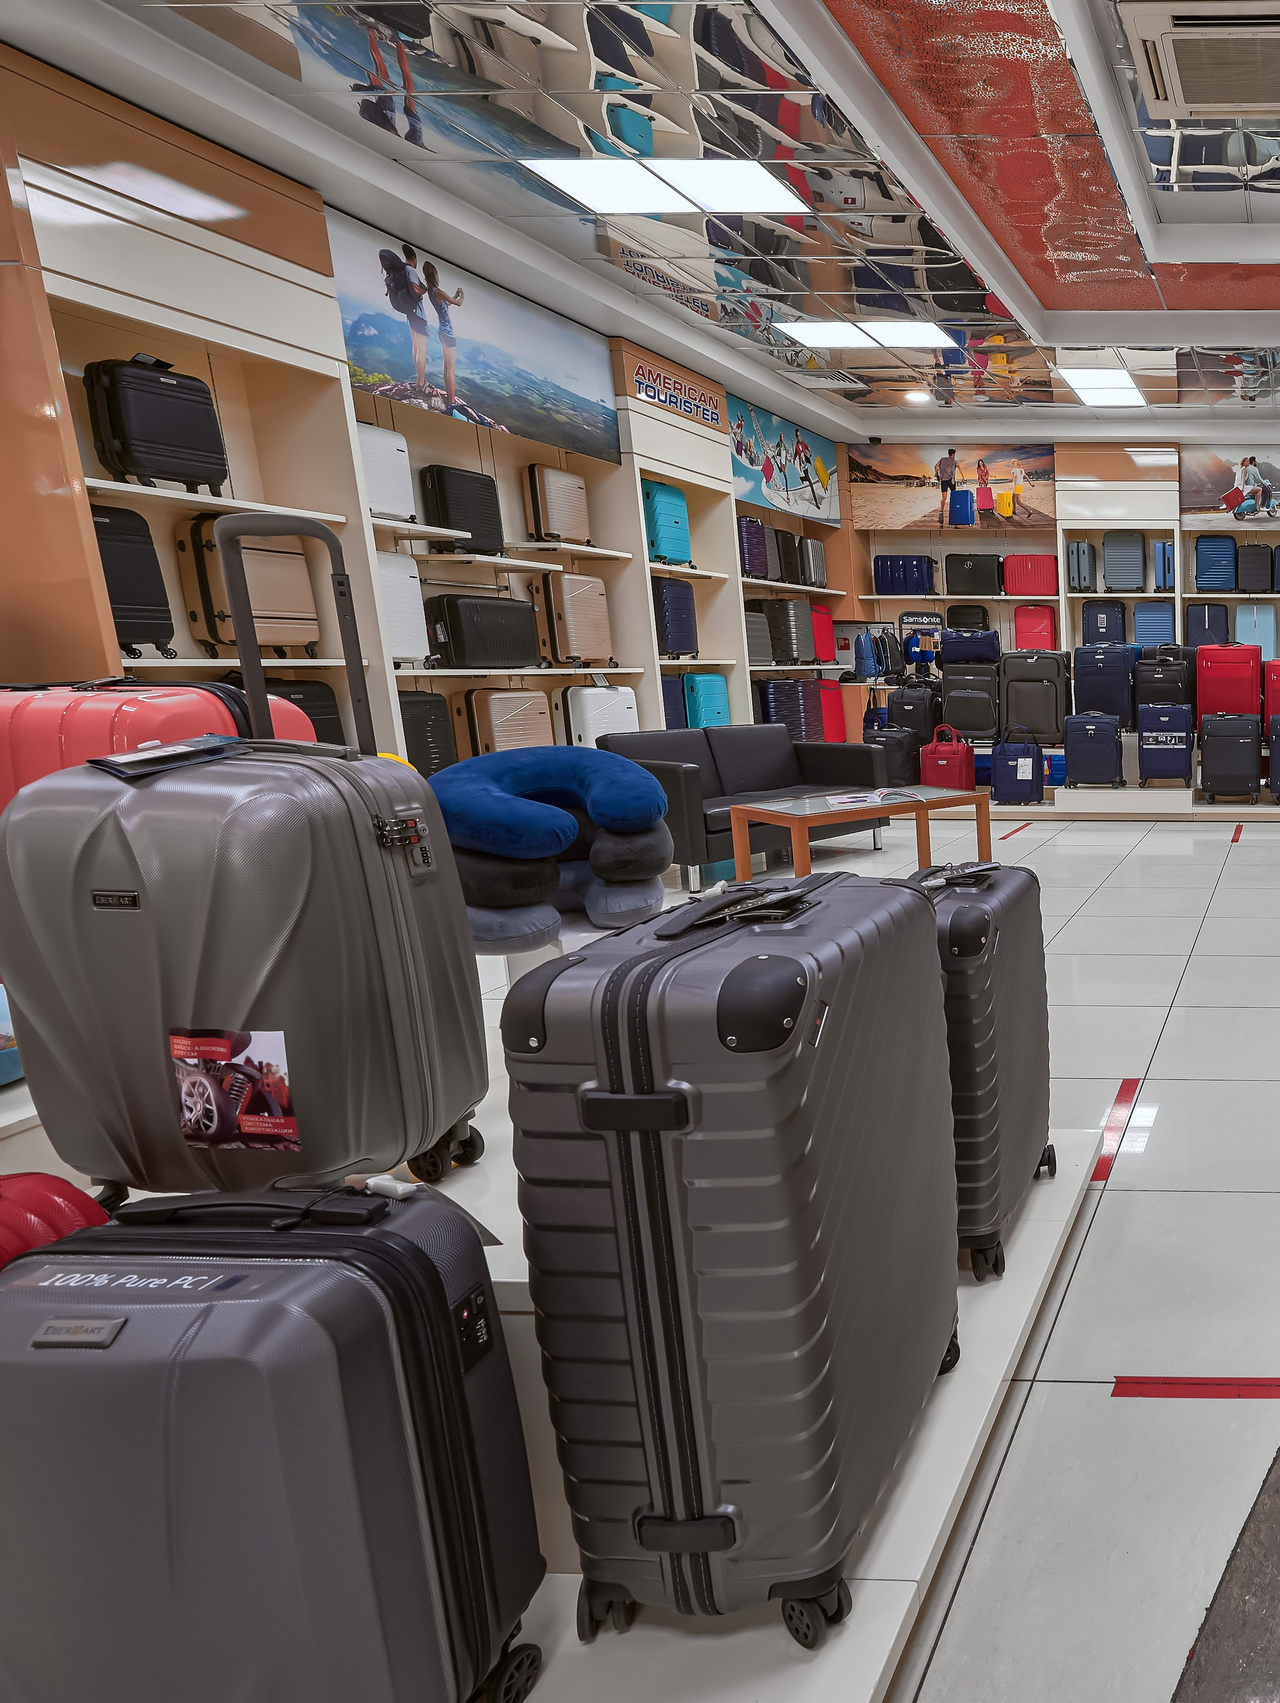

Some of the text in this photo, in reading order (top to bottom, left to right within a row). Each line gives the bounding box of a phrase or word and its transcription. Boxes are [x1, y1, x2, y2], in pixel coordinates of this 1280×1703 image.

[634, 364, 719, 411] AMERICAN
[634, 379, 720, 426] TOURISTER
[902, 616, 941, 624] Samsonite
[38, 1273, 116, 1287] 100%
[111, 1276, 168, 1288] Pure
[166, 1275, 209, 1289] PC
